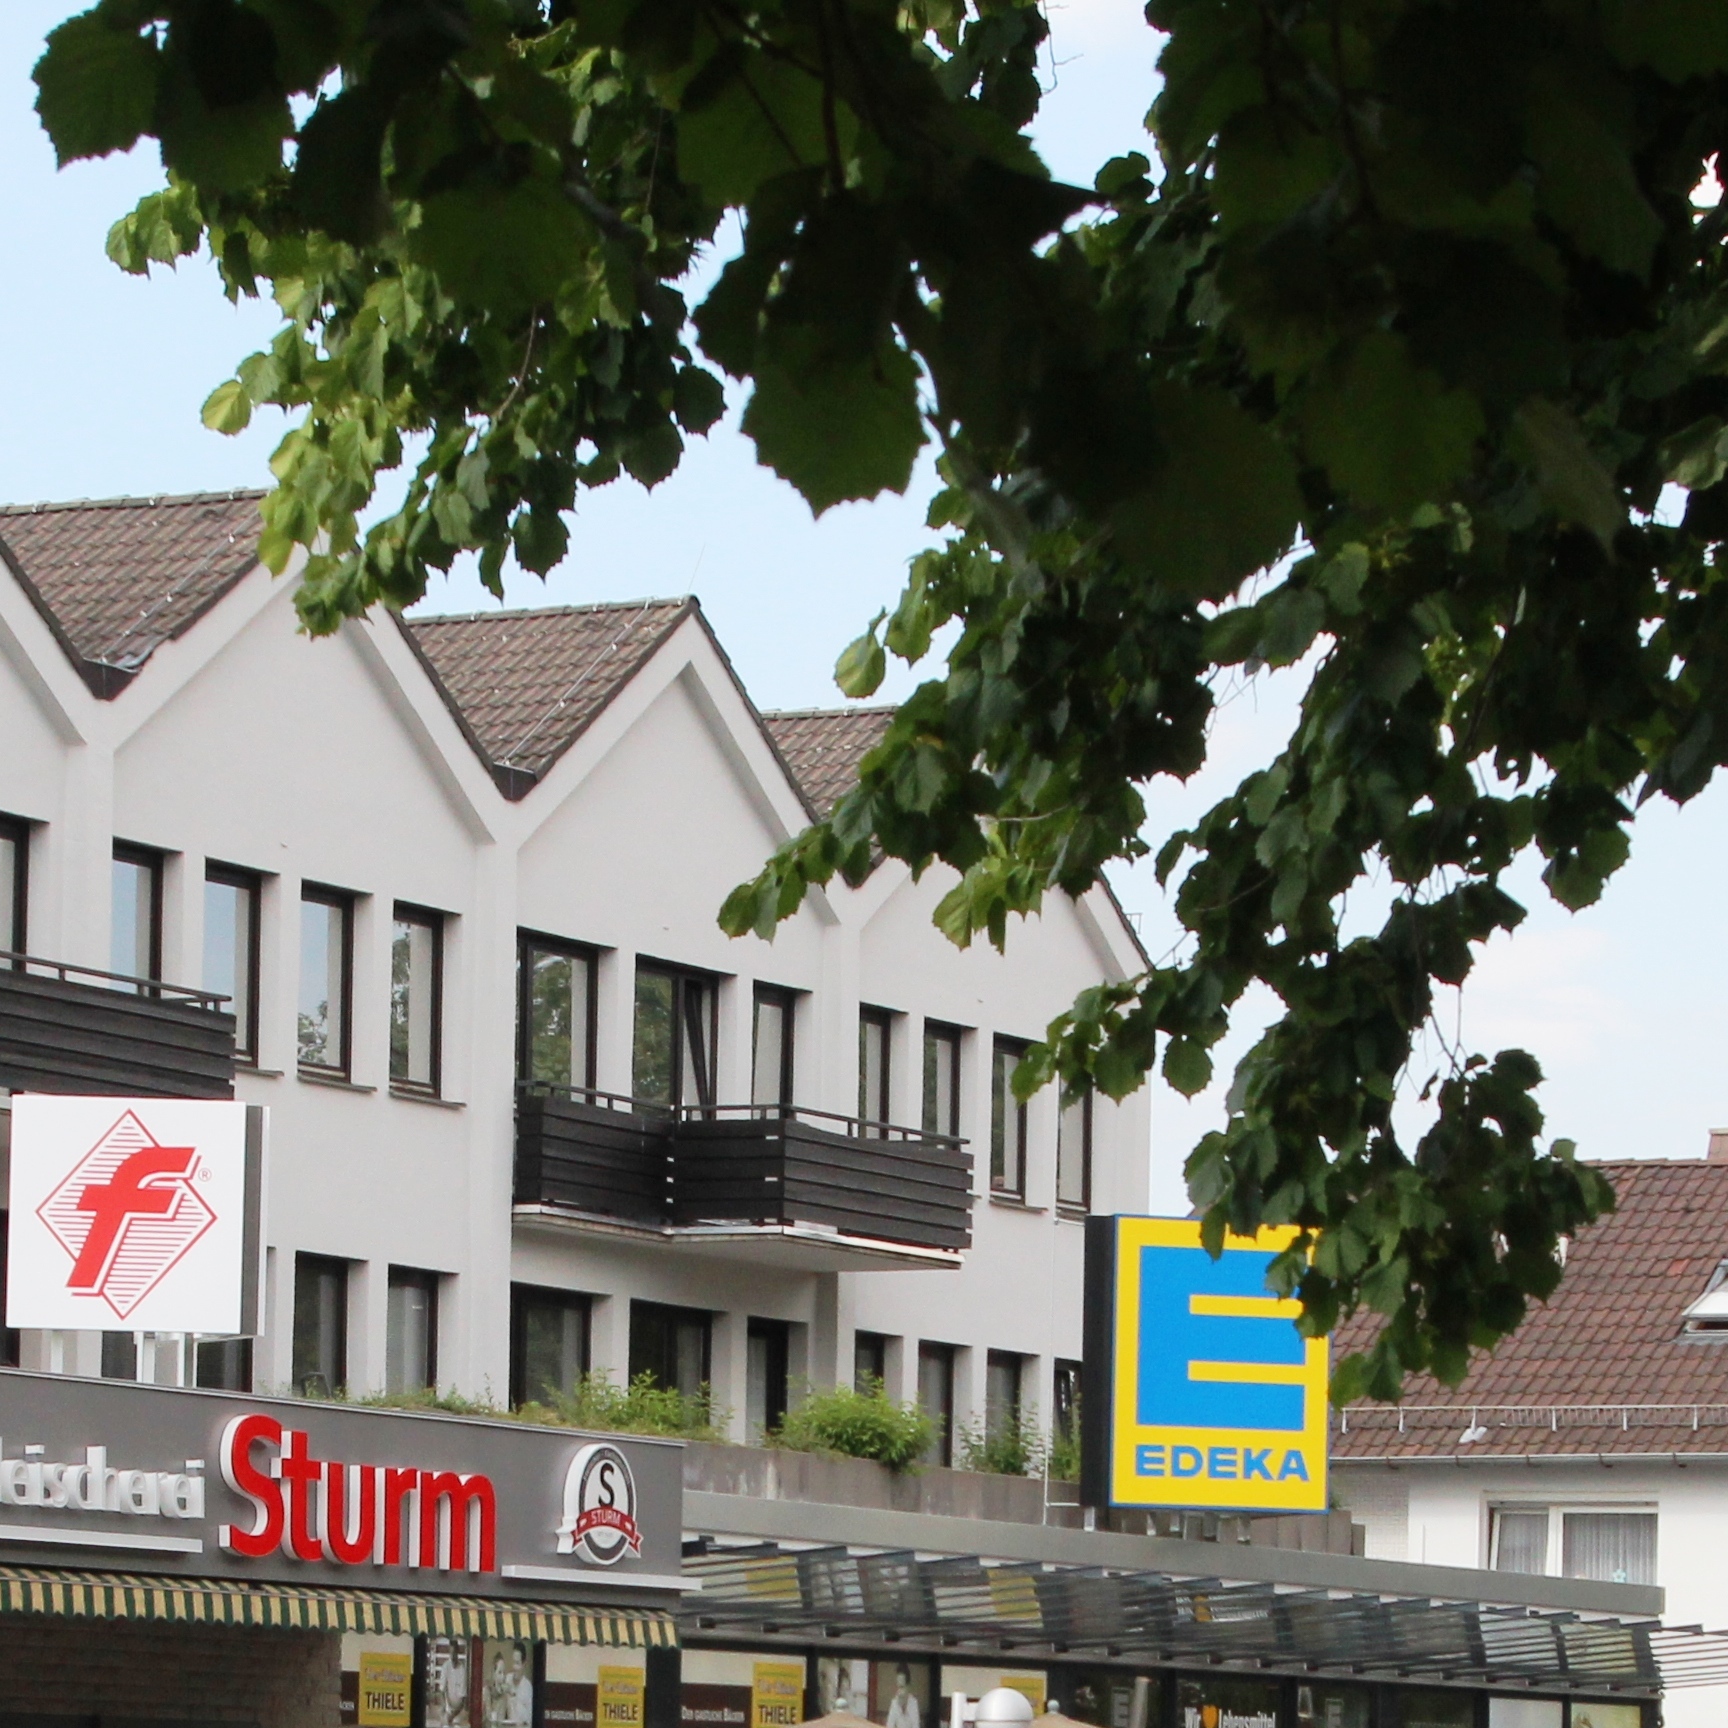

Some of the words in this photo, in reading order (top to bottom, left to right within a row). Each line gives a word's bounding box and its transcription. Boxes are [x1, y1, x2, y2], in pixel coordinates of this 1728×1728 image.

[1136, 1444, 1310, 1482] EDEKA
[220, 1414, 496, 1573] Sturm
[591, 1509, 621, 1526] STURM
[365, 1691, 406, 1711] THIELE
[602, 1702, 639, 1721] THIELE
[758, 1704, 797, 1725] THIELE
